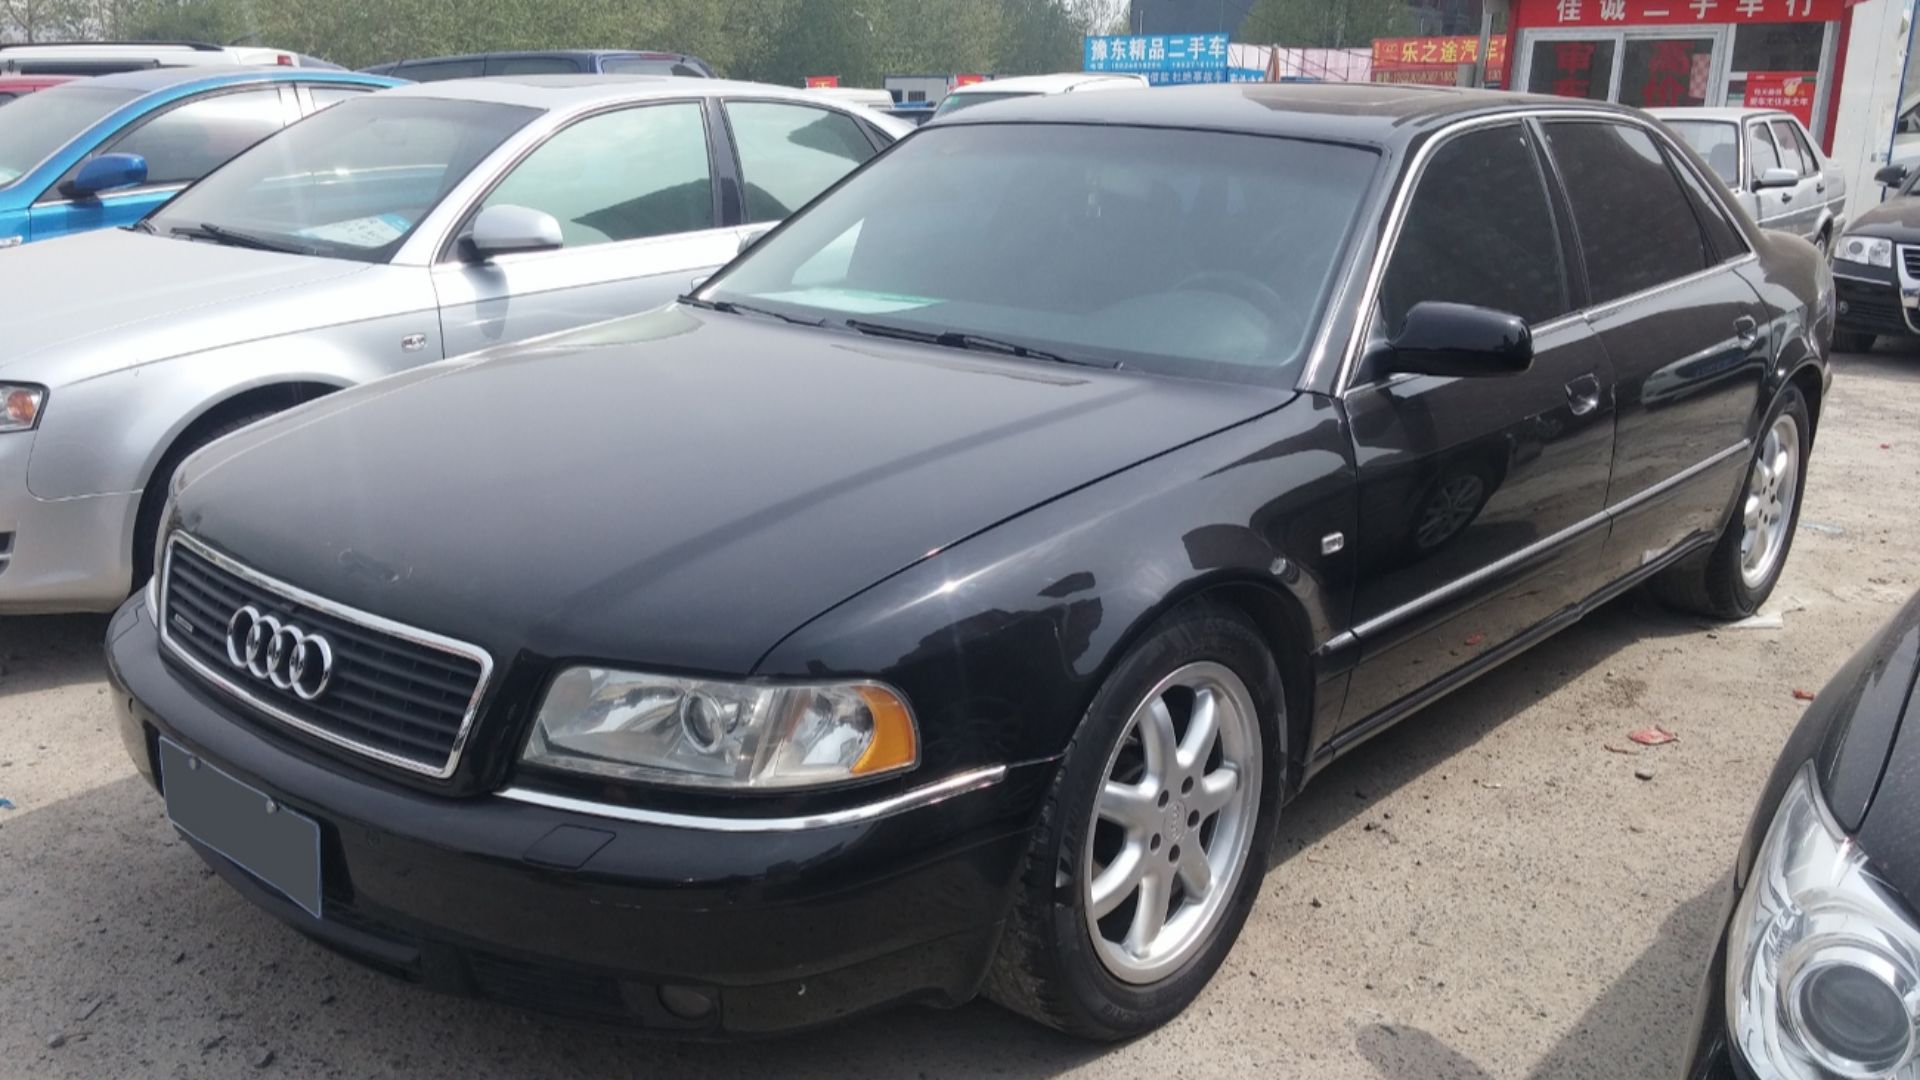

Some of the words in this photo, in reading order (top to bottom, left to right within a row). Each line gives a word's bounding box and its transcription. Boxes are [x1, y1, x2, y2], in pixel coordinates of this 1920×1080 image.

[1091, 36, 1226, 61] 豫东精品二手车
